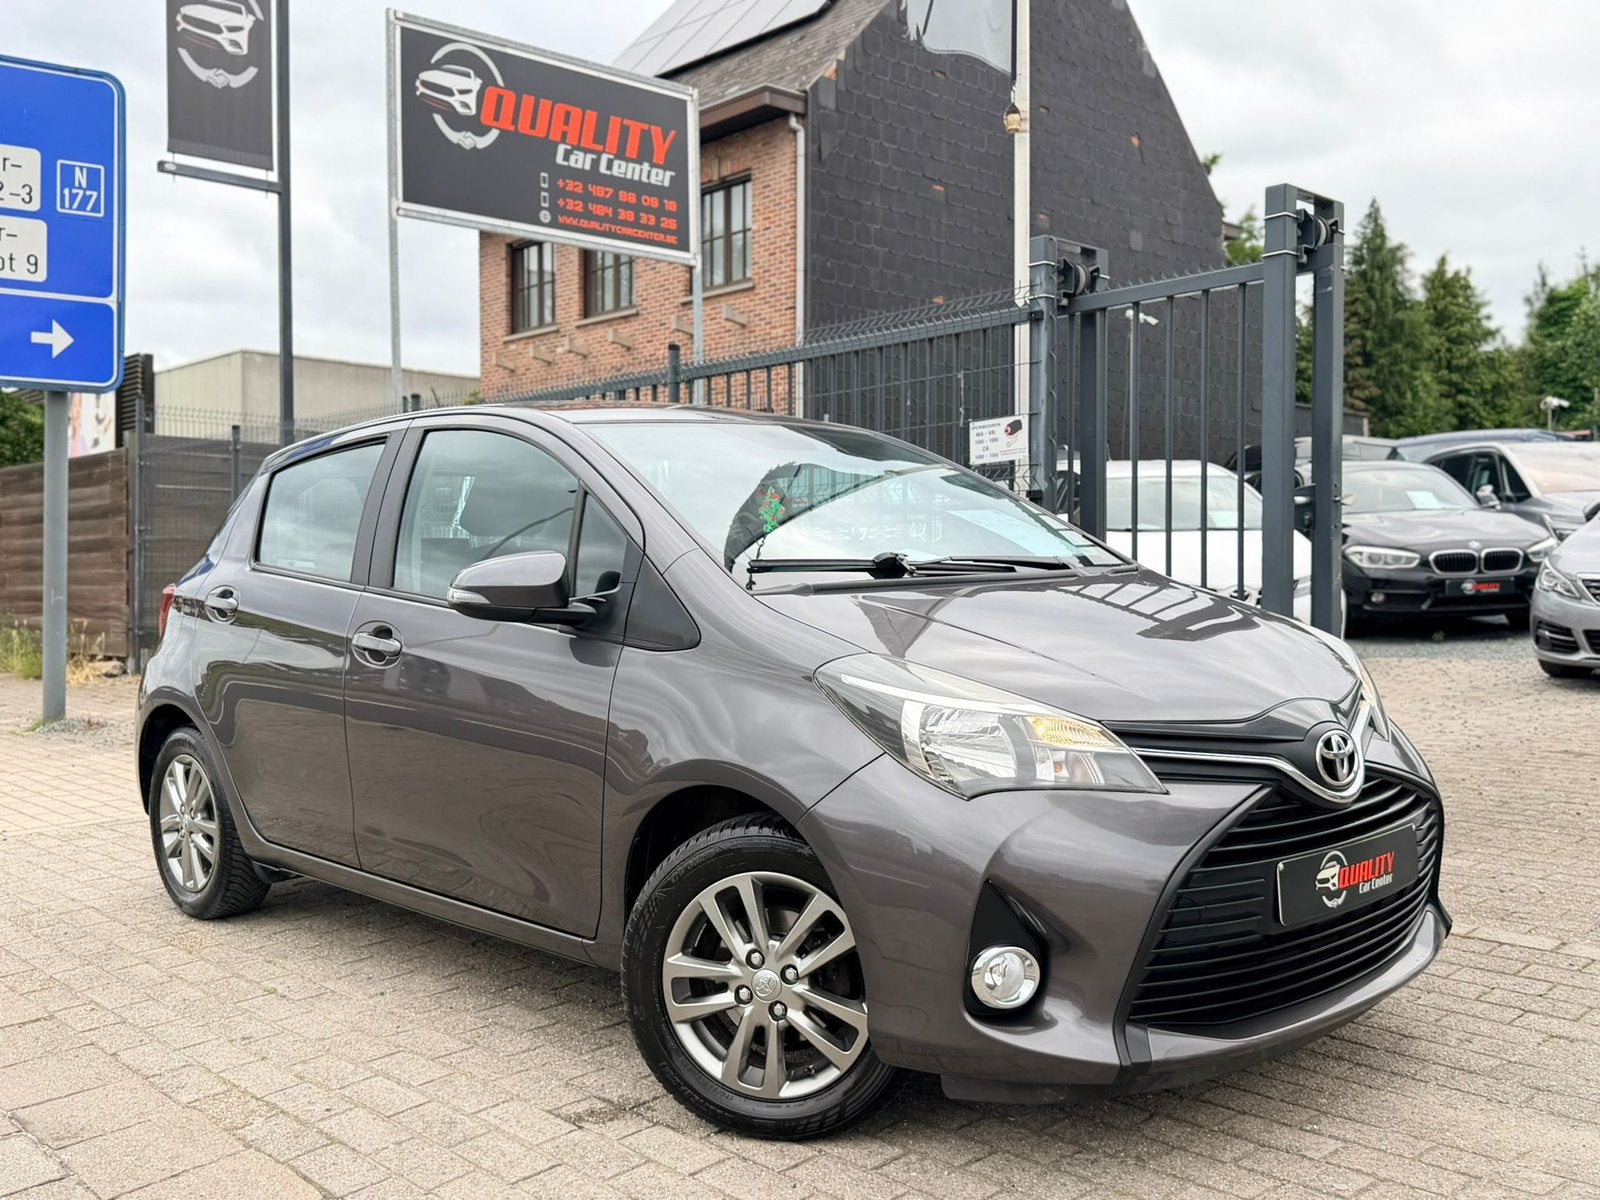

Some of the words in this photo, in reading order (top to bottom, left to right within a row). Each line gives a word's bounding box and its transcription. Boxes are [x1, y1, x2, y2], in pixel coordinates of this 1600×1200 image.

[480, 86, 677, 165] QUALITY
[555, 143, 597, 171] Car
[599, 153, 676, 187] Center
[74, 166, 88, 189] N
[557, 179, 584, 194] +32
[62, 187, 99, 212] 177
[557, 197, 584, 213] +32
[1339, 851, 1395, 889] QUALITY
[1359, 881, 1371, 894] Car
[1371, 873, 1393, 890] Center
